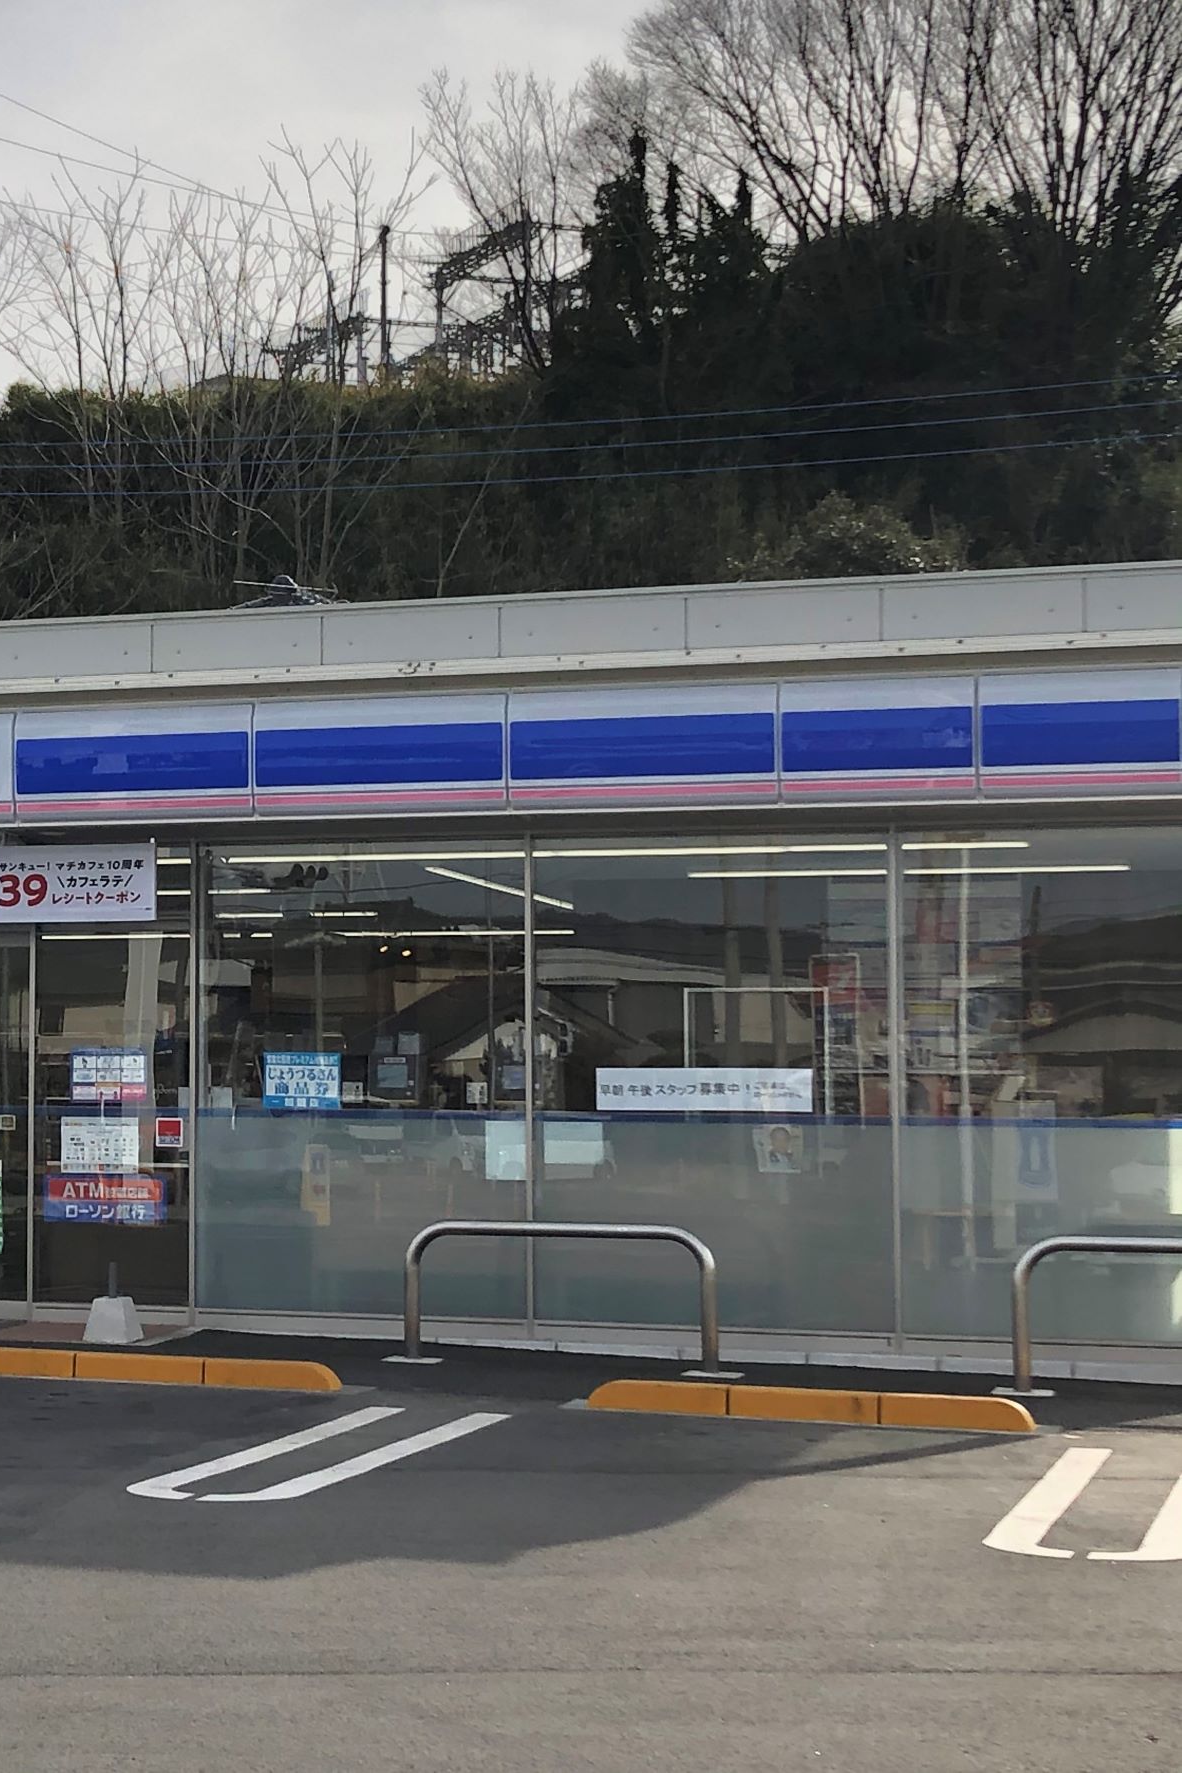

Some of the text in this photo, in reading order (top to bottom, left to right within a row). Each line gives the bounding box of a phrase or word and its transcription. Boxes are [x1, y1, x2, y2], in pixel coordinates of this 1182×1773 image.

[52, 892, 141, 905] レシートクーポン
[66, 1203, 146, 1220] ローソン銀行
